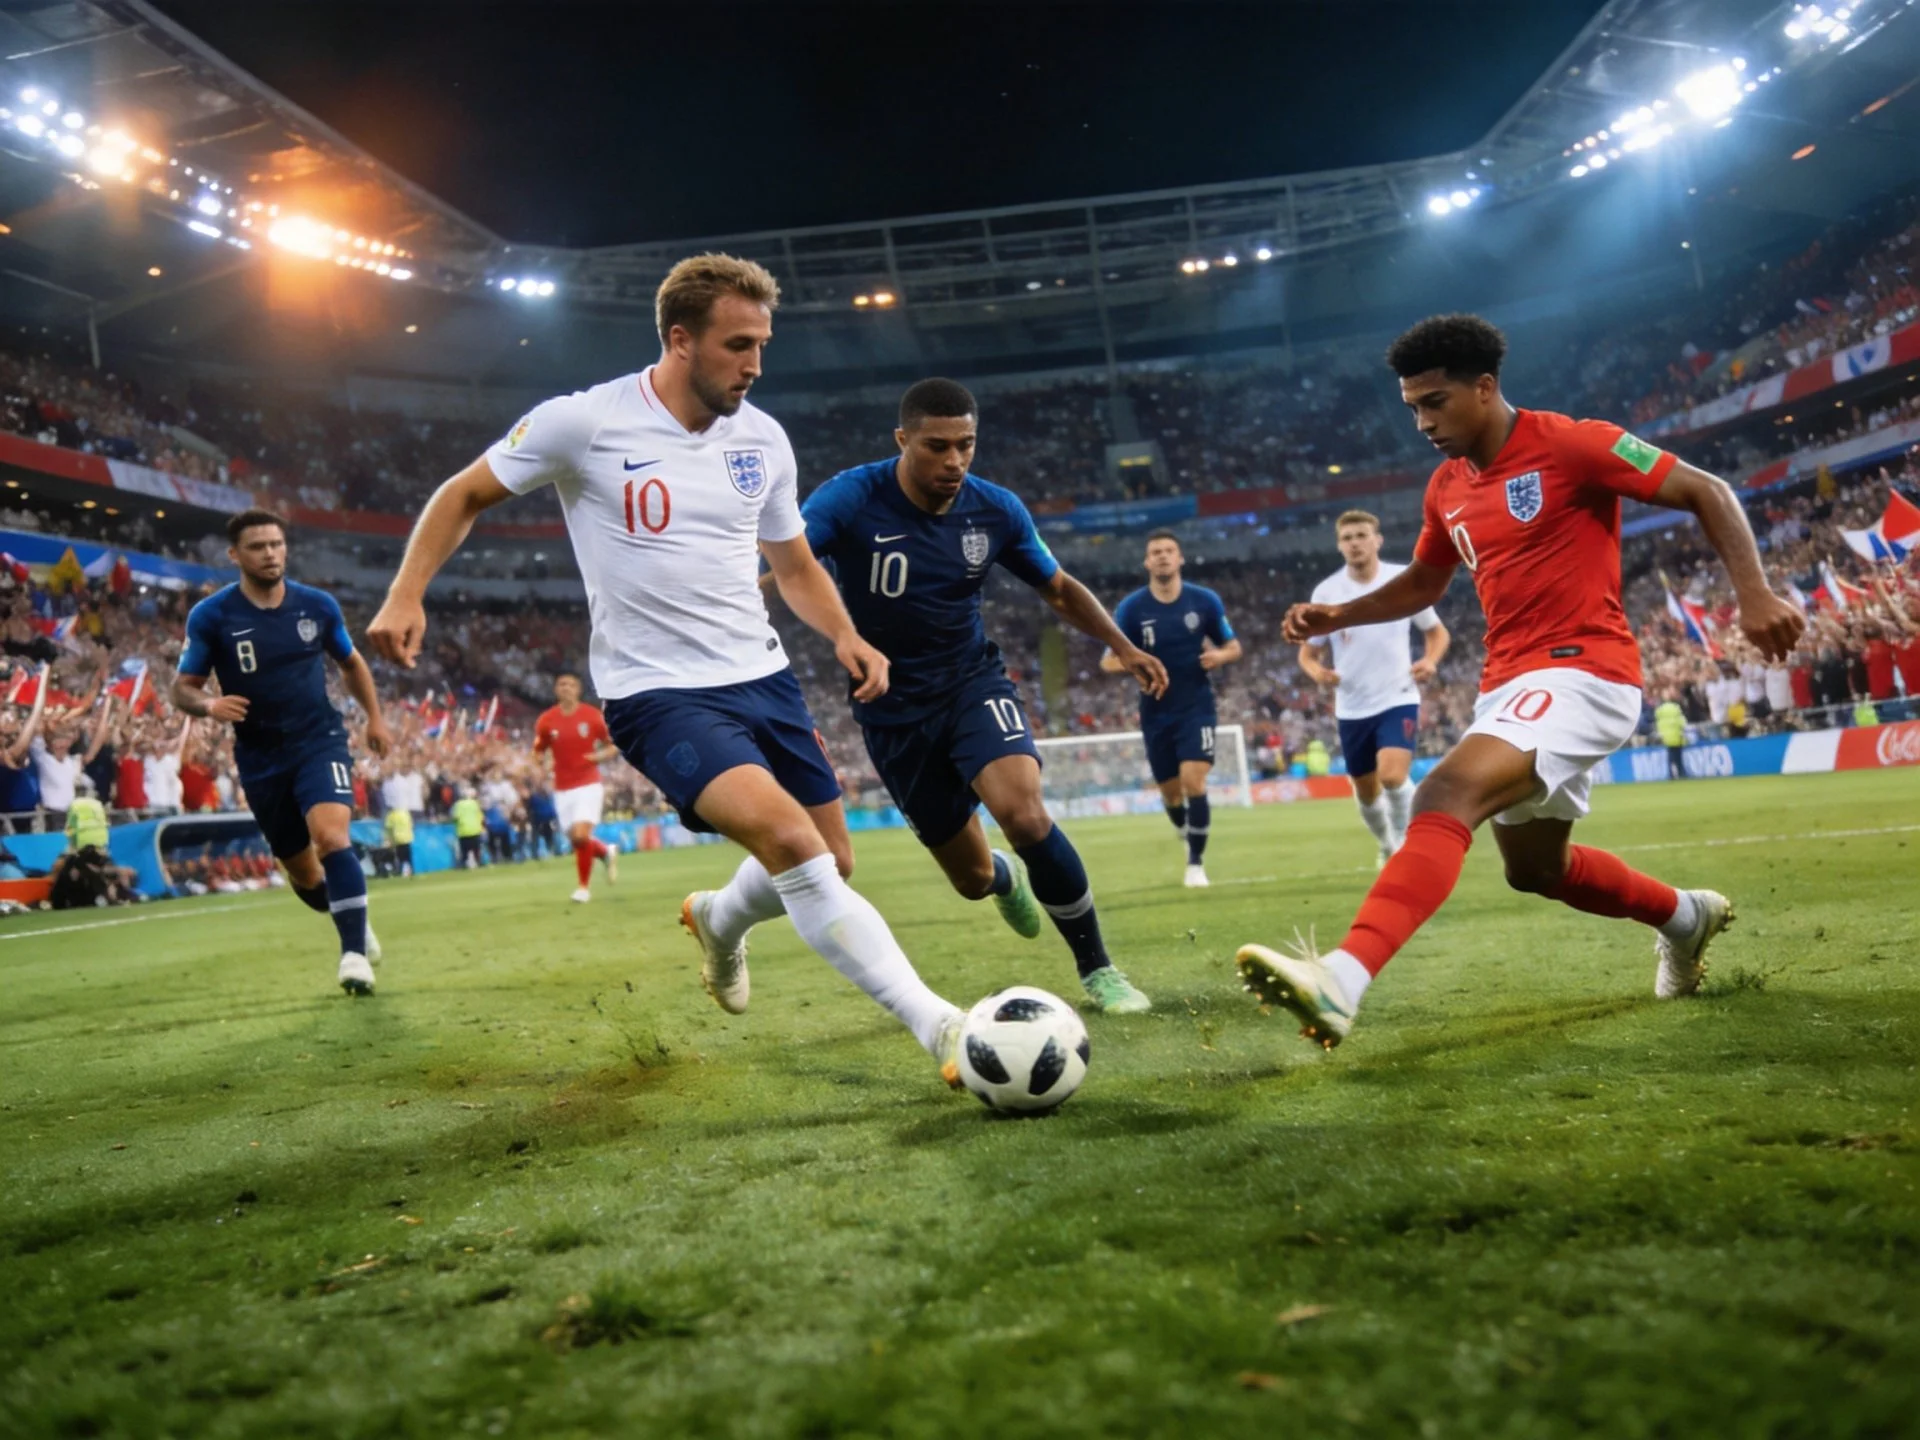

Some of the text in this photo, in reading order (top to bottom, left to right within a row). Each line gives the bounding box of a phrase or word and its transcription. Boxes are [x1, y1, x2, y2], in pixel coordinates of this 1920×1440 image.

[624, 478, 671, 534] 10
[1449, 523, 1477, 571] 0
[869, 551, 908, 598] 10
[984, 698, 1025, 732] 10
[1502, 687, 1553, 722] 10
[331, 761, 350, 787] 11
